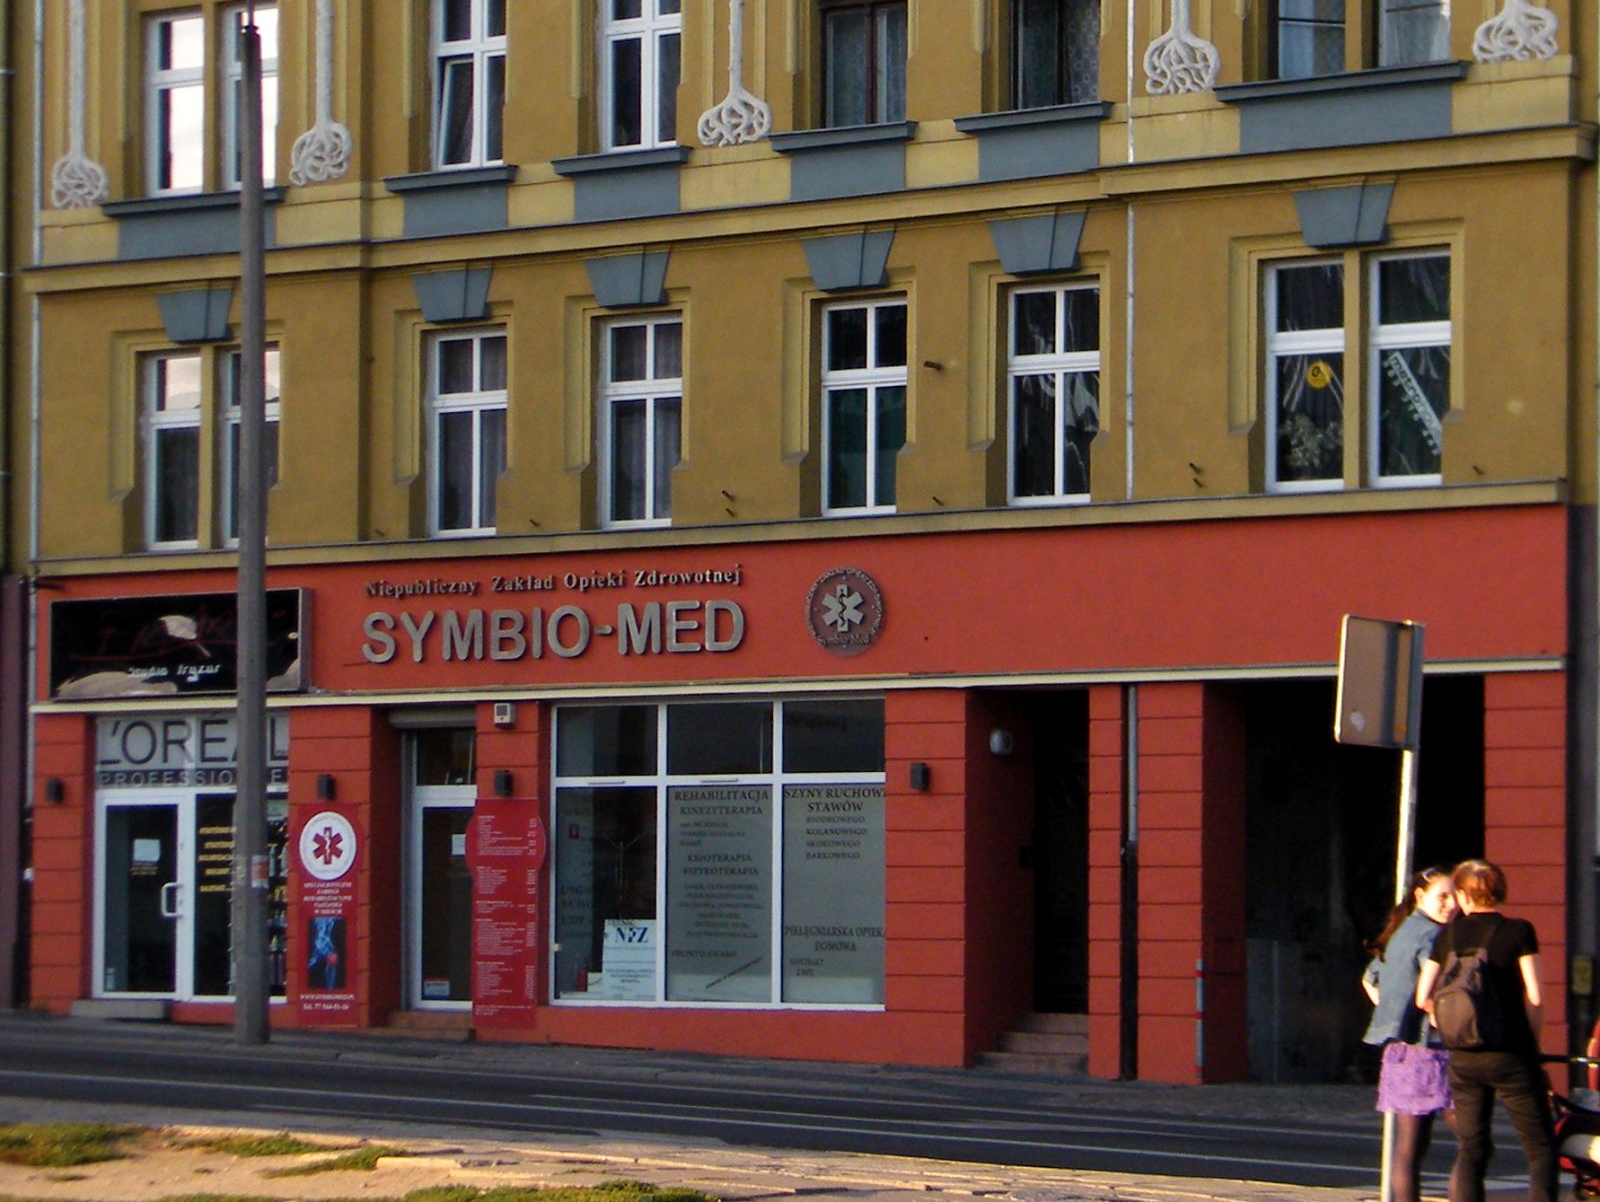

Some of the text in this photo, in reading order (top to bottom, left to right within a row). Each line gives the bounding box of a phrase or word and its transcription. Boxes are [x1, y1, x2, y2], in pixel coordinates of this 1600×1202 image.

[367, 563, 742, 598] Niepubliczny Zakład Opieki Zdrowotnej
[362, 600, 745, 663] SYMBIO-MED
[99, 767, 283, 788] PROFESSIOE
[674, 789, 769, 803] REHABILITACJA
[784, 787, 886, 799] SZYNY RUCHOW
[680, 805, 763, 815] KINEZYTERAPIA
[807, 799, 864, 813] STAWÓW
[615, 926, 649, 943] NFZ
[855, 925, 886, 938] OPIEK
